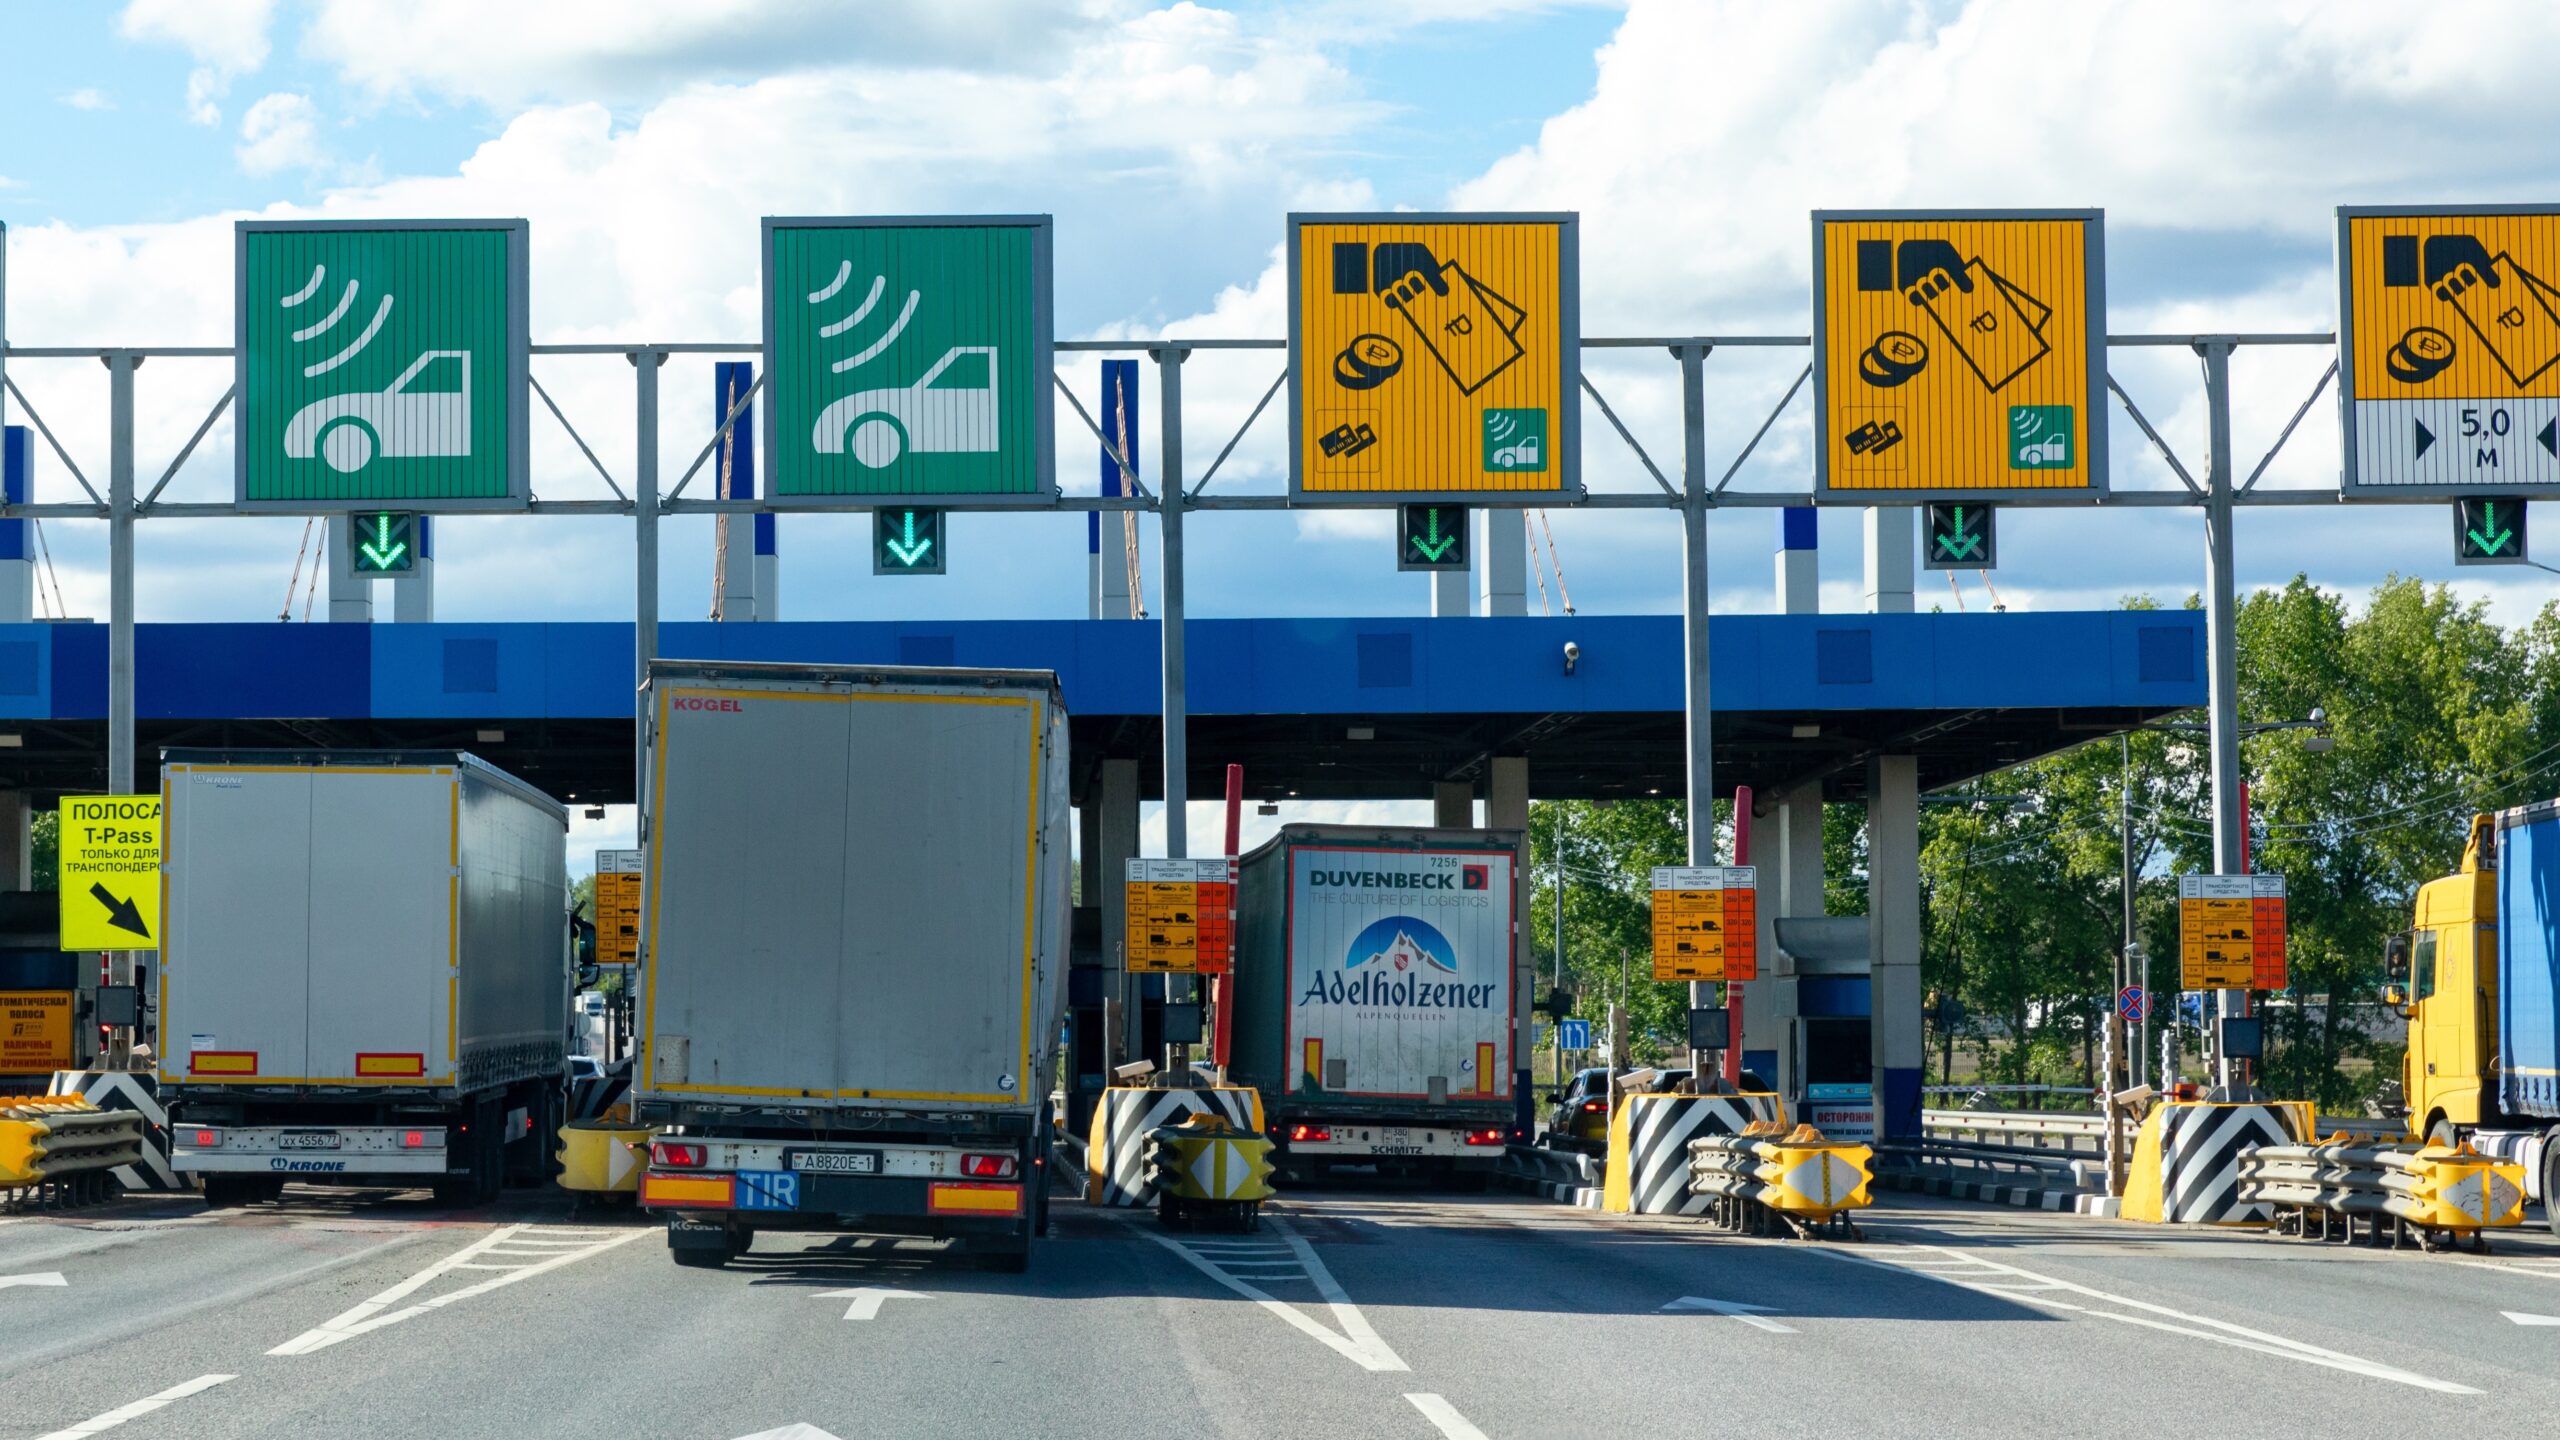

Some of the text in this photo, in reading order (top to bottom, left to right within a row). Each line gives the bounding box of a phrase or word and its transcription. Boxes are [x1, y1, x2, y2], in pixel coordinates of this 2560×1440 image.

[2461, 408, 2511, 441] 5,0
[73, 803, 161, 820] ПОЛОСА
[84, 827, 153, 844] T-Pass
[81, 848, 159, 861] ТОЛЬКО ДЛЯ
[1431, 857, 1457, 867] 7256
[1310, 870, 1455, 889] DUVENBECK
[1311, 892, 1488, 908] THE CULTURE OF LOGISTICS
[1298, 969, 1496, 1008] Adelholzener
[0, 998, 68, 1007] ТОМАТИЧЕСКАЯ
[10, 1010, 45, 1019] ПОЛОСА
[1356, 1012, 1446, 1021] ALPENQUELLEN
[298, 1136, 323, 1145] 4556
[326, 1135, 337, 1143] 77
[1371, 1146, 1423, 1154] SCHMITZ
[289, 1161, 345, 1171] KRONE
[740, 1173, 795, 1207] TIR
